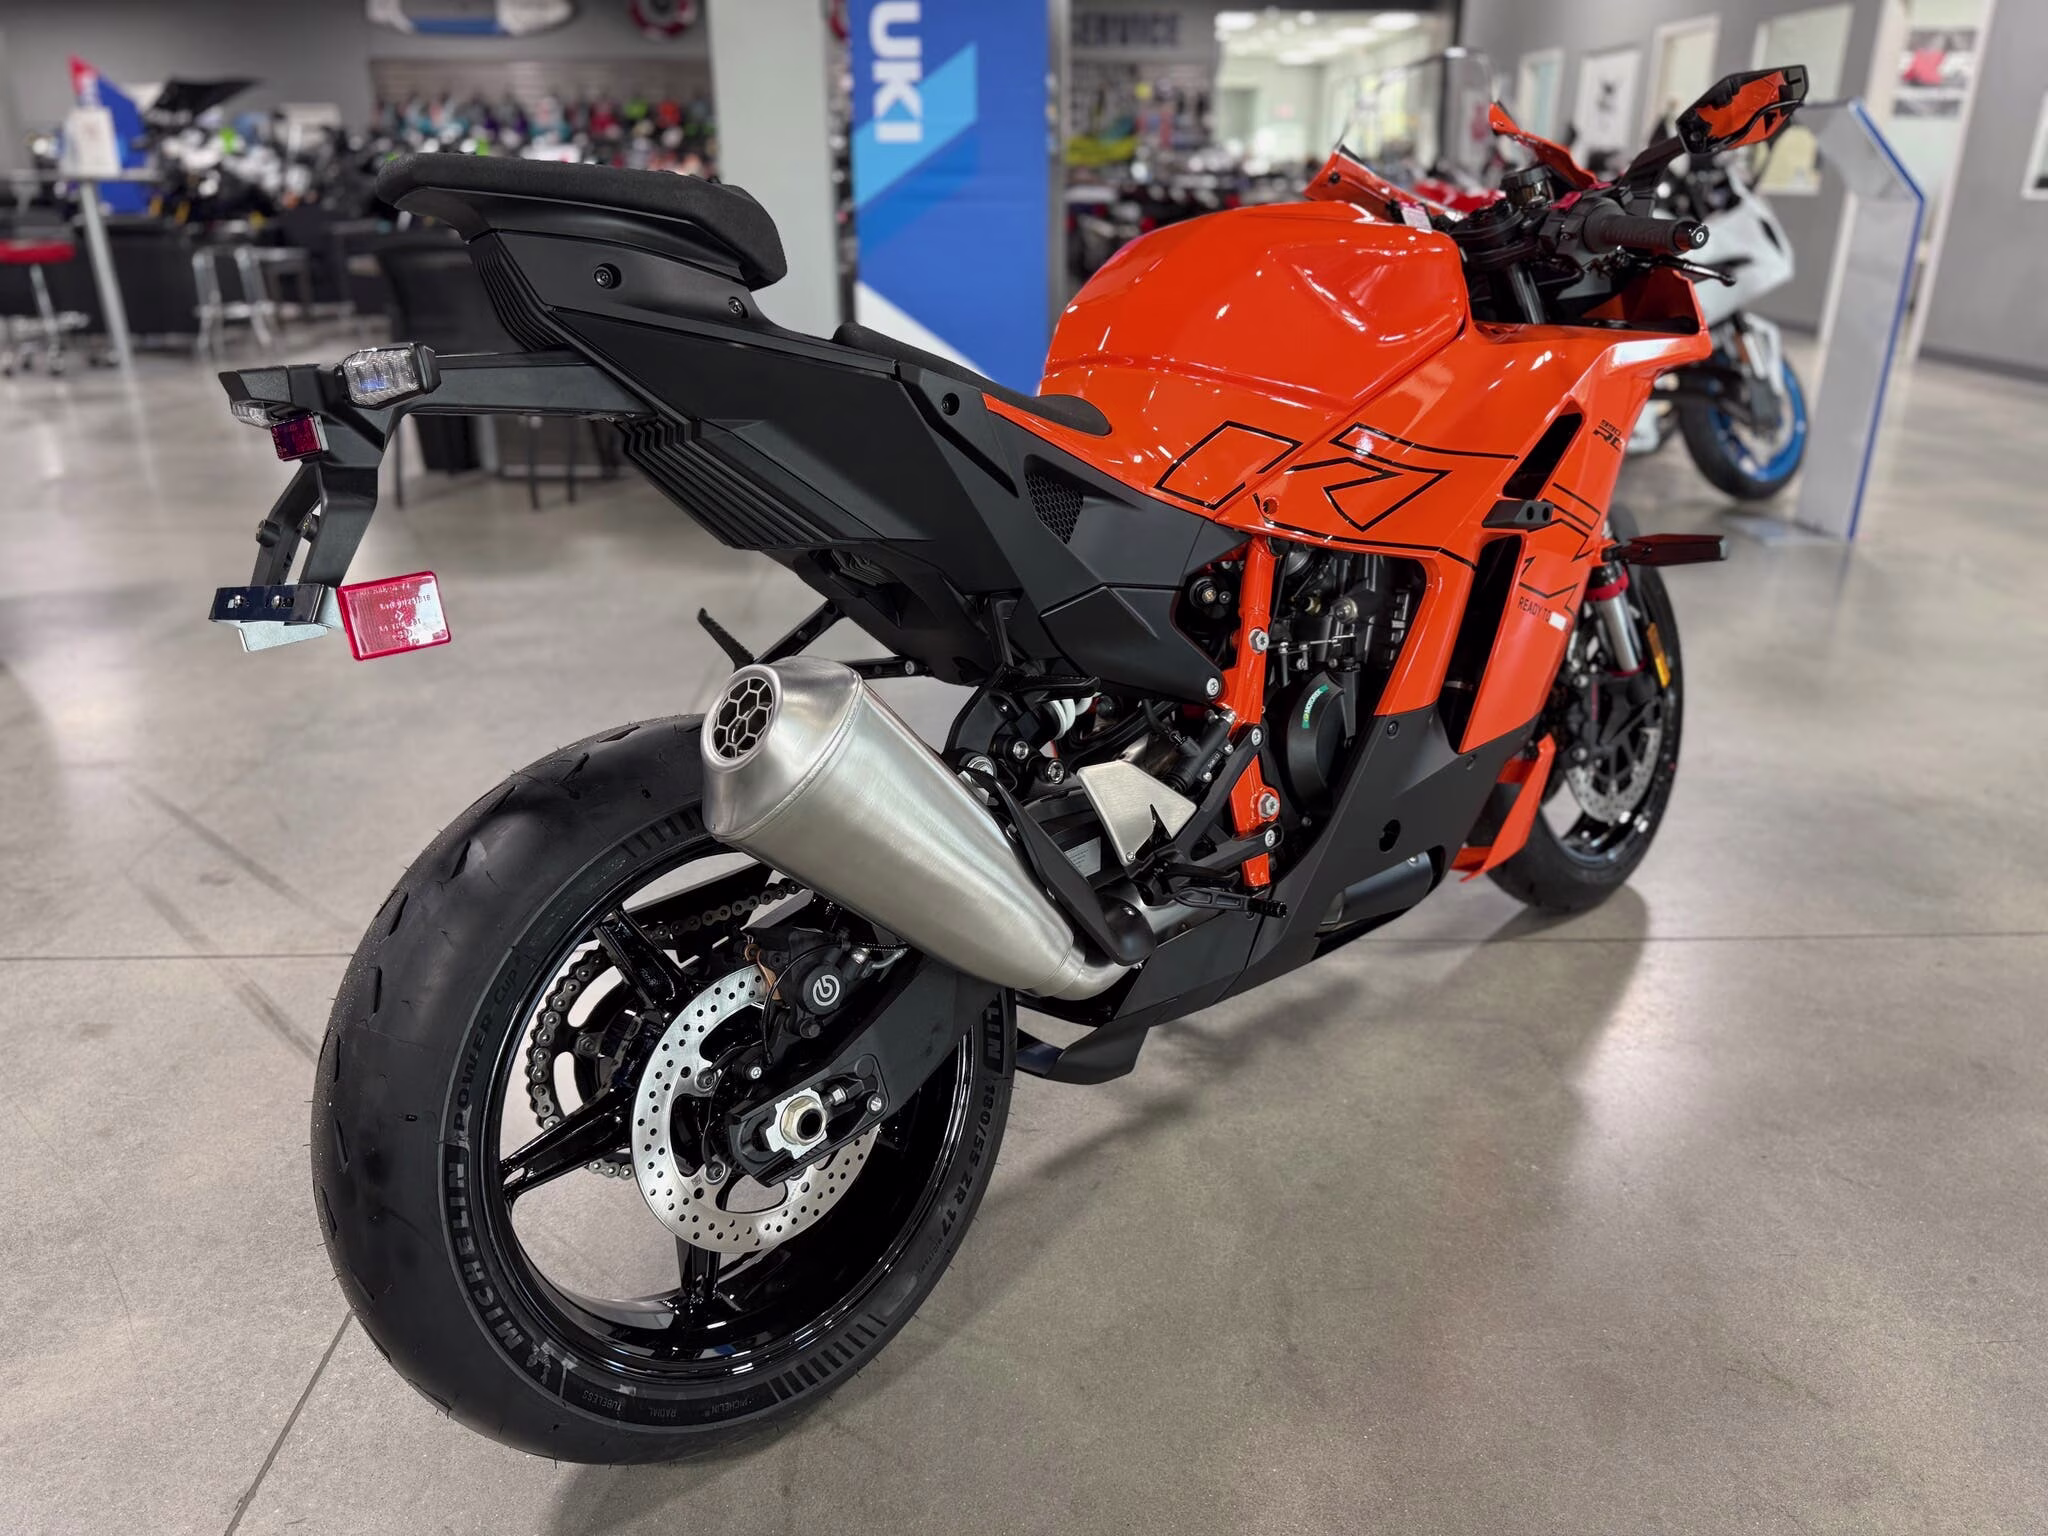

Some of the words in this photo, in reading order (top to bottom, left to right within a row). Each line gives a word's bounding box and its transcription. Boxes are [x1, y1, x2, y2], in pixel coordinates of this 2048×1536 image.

[869, 1, 922, 142] UKI
[1518, 596, 1543, 616] READY
[453, 1014, 493, 1132] POWER
[968, 1085, 995, 1167] 180/55
[954, 1171, 972, 1204] ZR
[941, 1209, 956, 1236] 17
[449, 1163, 524, 1349] MICHELIN
[583, 1390, 623, 1411] TUBELESS
